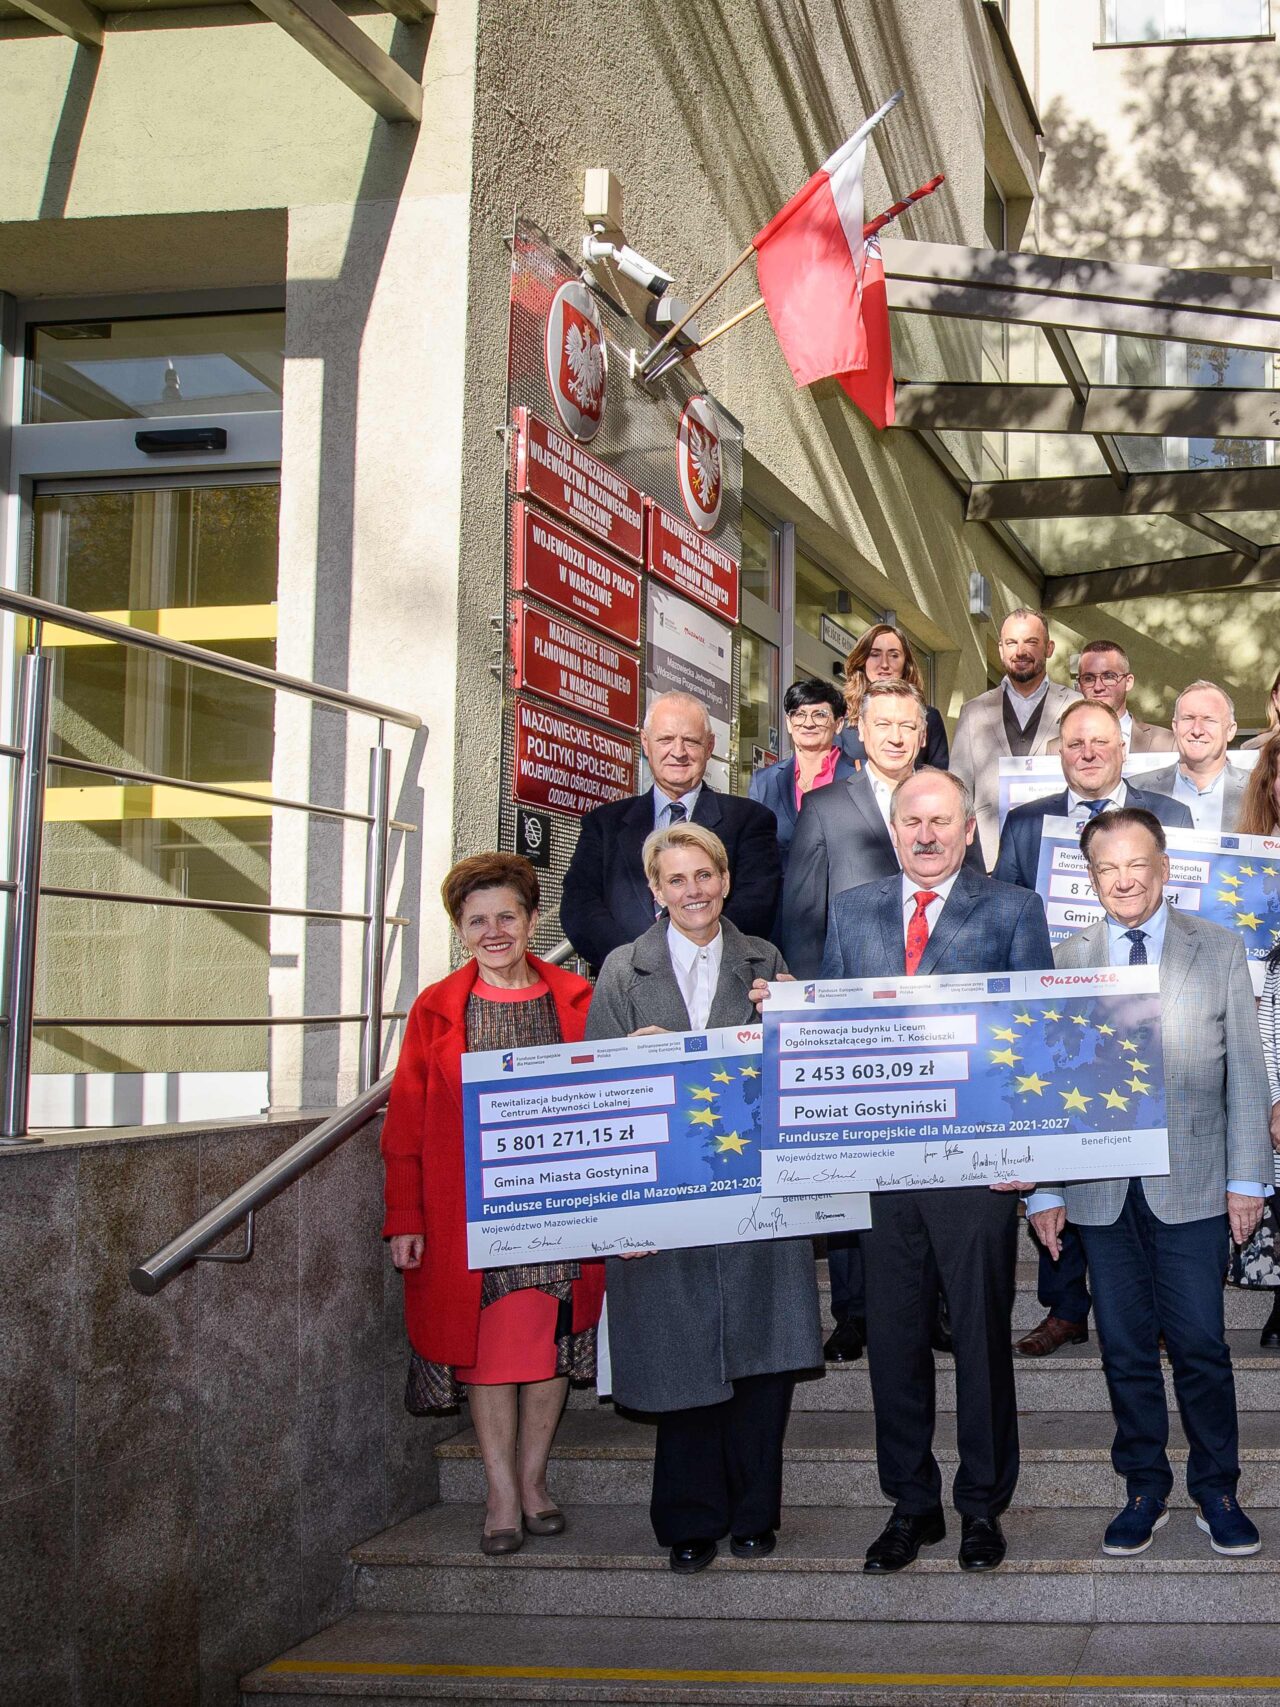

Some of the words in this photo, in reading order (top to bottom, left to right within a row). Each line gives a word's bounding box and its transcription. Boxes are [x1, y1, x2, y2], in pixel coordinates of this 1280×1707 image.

[548, 430, 572, 462] URZĄD
[572, 448, 628, 502] MARSZAŁKOWSKI
[530, 440, 587, 493] WOJEWÓDZTWA
[588, 480, 640, 529] MAZOWIECKIEGO
[564, 484, 572, 503] W
[572, 490, 612, 530] WARSZAWIE
[660, 512, 700, 552] MAZOWIECKA
[701, 541, 732, 574] JEDNOSTKA
[532, 524, 586, 570] WOJEWÓDZKI
[588, 557, 610, 586] URZĄD
[612, 572, 635, 598] PRACY
[681, 544, 714, 579] WDRAŻANIA
[559, 564, 568, 584] W
[568, 569, 612, 608] WARSZAWIE
[662, 550, 702, 588] PROGRAMÓW
[702, 576, 728, 605] UNIJNYCH
[549, 621, 598, 660] MAZOWIECKIE
[600, 646, 619, 670] BIURO
[534, 636, 581, 672] PLANOWANIA
[582, 659, 630, 696] REGIONALNEGO
[666, 656, 695, 678] Mazowiecka
[695, 671, 716, 688] Jednostka
[560, 669, 568, 688] W
[569, 673, 608, 706] WARSZAWIE
[656, 664, 682, 684] Wdrażania
[682, 677, 706, 696] Programów
[706, 689, 723, 704] Unijnych
[522, 707, 592, 749] MAZOWIECKIE
[592, 734, 632, 765] CENTRUM
[520, 758, 570, 788] WOJEWÓDZKI
[570, 772, 600, 796] OŚRODEK
[527, 736, 574, 767] POLITYKI
[576, 752, 630, 786] SPOŁECZNEJ
[548, 788, 576, 809] ODDZIAŁ
[578, 796, 586, 812] W
[1169, 872, 1202, 881] owicach
[1170, 864, 1202, 873] zespołu
[1070, 883, 1078, 895] 8
[1167, 894, 1179, 904] zł
[1050, 930, 1072, 939] und
[785, 1036, 878, 1048] Ogólnokształcącego
[881, 1035, 894, 1043] im.
[898, 1034, 905, 1042] T.
[908, 1032, 955, 1042] Kościuszki
[800, 1027, 848, 1036] Renowacja
[852, 1025, 890, 1035] budynku
[894, 1023, 926, 1032] Liceum
[795, 1068, 805, 1082] 2
[812, 1066, 845, 1081] 453
[852, 1062, 914, 1080] 603,09
[919, 1060, 934, 1076] zł
[491, 1096, 548, 1108] Rewitalizacja
[552, 1091, 596, 1103] budynków
[599, 1090, 602, 1098] i
[604, 1086, 654, 1097] utworzenie
[501, 1108, 538, 1118] Centrum
[542, 1102, 590, 1115] Aktywności
[593, 1098, 631, 1109] Lokalnej
[794, 1104, 848, 1120] Powiat
[854, 1099, 947, 1119] Gostyniński
[497, 1138, 506, 1153] 5
[514, 1134, 545, 1151] 801
[553, 1127, 613, 1148] 271,15
[619, 1125, 635, 1141] zł
[778, 1130, 839, 1143] Fundusze
[842, 1126, 916, 1142] Europejskie
[920, 1125, 938, 1136] dla
[942, 1122, 1006, 1135] Mazowsza
[1008, 1118, 1070, 1132] 2021-2027
[776, 1152, 838, 1163] Województwo
[840, 1149, 895, 1159] Mazowieckie
[1081, 1135, 1132, 1146] Beneficjent
[494, 1174, 534, 1188] Gmina
[540, 1169, 582, 1184] Miasta
[586, 1164, 650, 1182] Gostynina
[482, 1200, 543, 1216] Fundusze
[546, 1192, 618, 1214] Europejskie
[620, 1188, 641, 1200] dla
[644, 1182, 708, 1199] Mazowsza
[710, 1176, 762, 1192] 2021-202
[482, 1221, 542, 1235] Województwo
[544, 1216, 598, 1228] Mazowieckie
